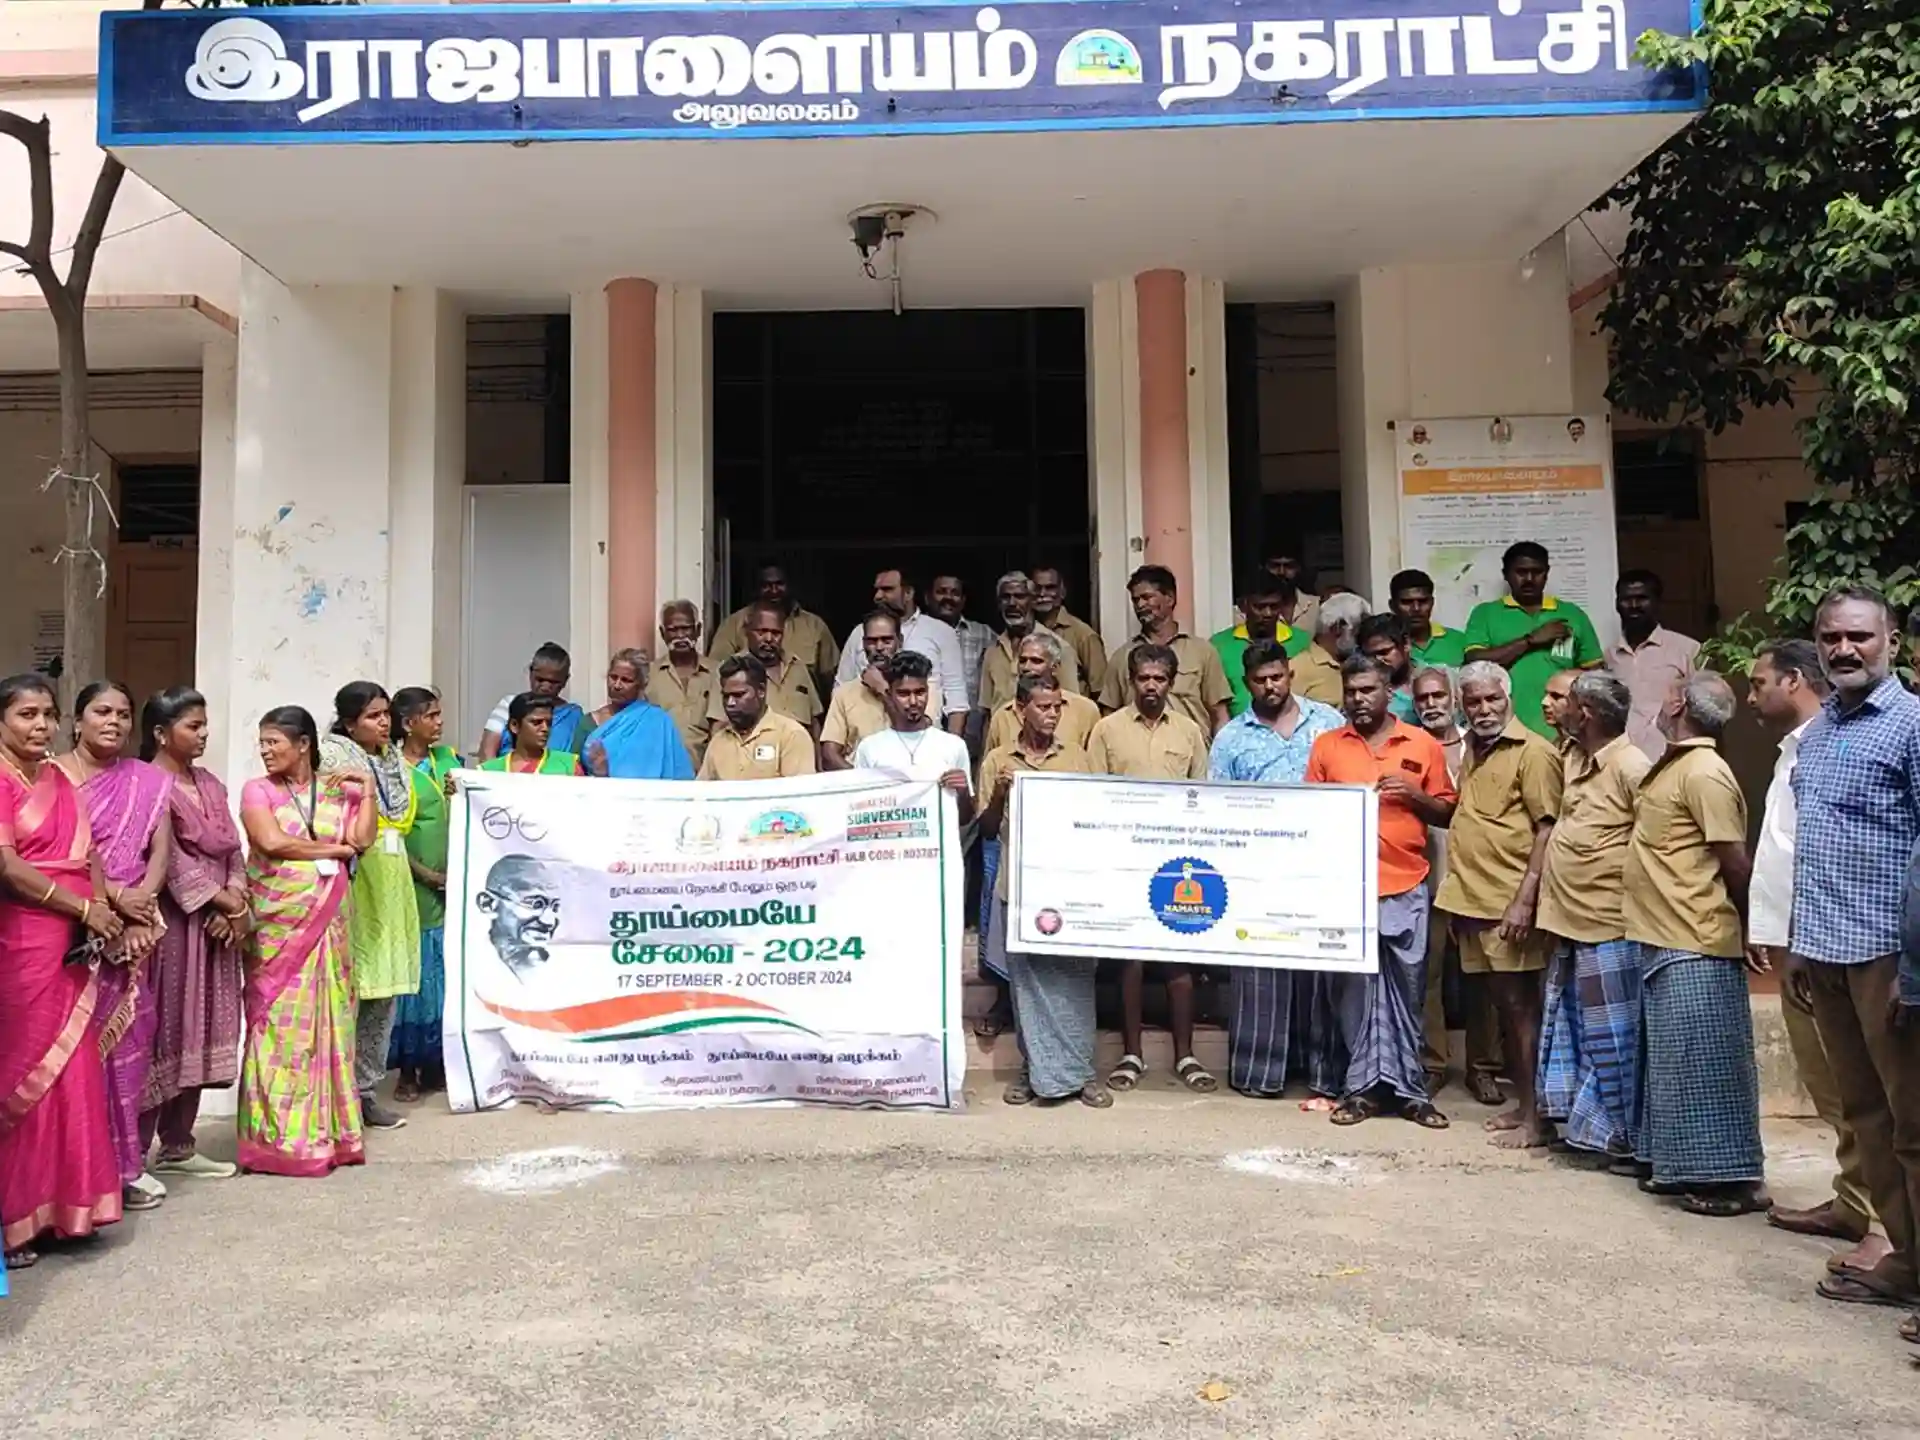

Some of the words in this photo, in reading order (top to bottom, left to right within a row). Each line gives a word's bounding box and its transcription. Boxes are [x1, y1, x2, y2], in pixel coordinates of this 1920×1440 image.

[185, 8, 1037, 125] இராஜபாளையம்
[1160, 0, 1628, 110] நகராட்சி
[673, 99, 859, 129] அலுவலகம்
[847, 807, 927, 825] SURVEKSHAN
[609, 899, 816, 938] தூய்மையே
[1163, 904, 1213, 915] NAMASTE
[611, 938, 734, 965] சேவை
[763, 935, 866, 963] 2024
[617, 974, 632, 988] 17
[635, 973, 724, 988] SEPTEMBER
[733, 973, 743, 986] 2
[746, 971, 816, 986] OCTOBER
[820, 970, 852, 985] 2024
